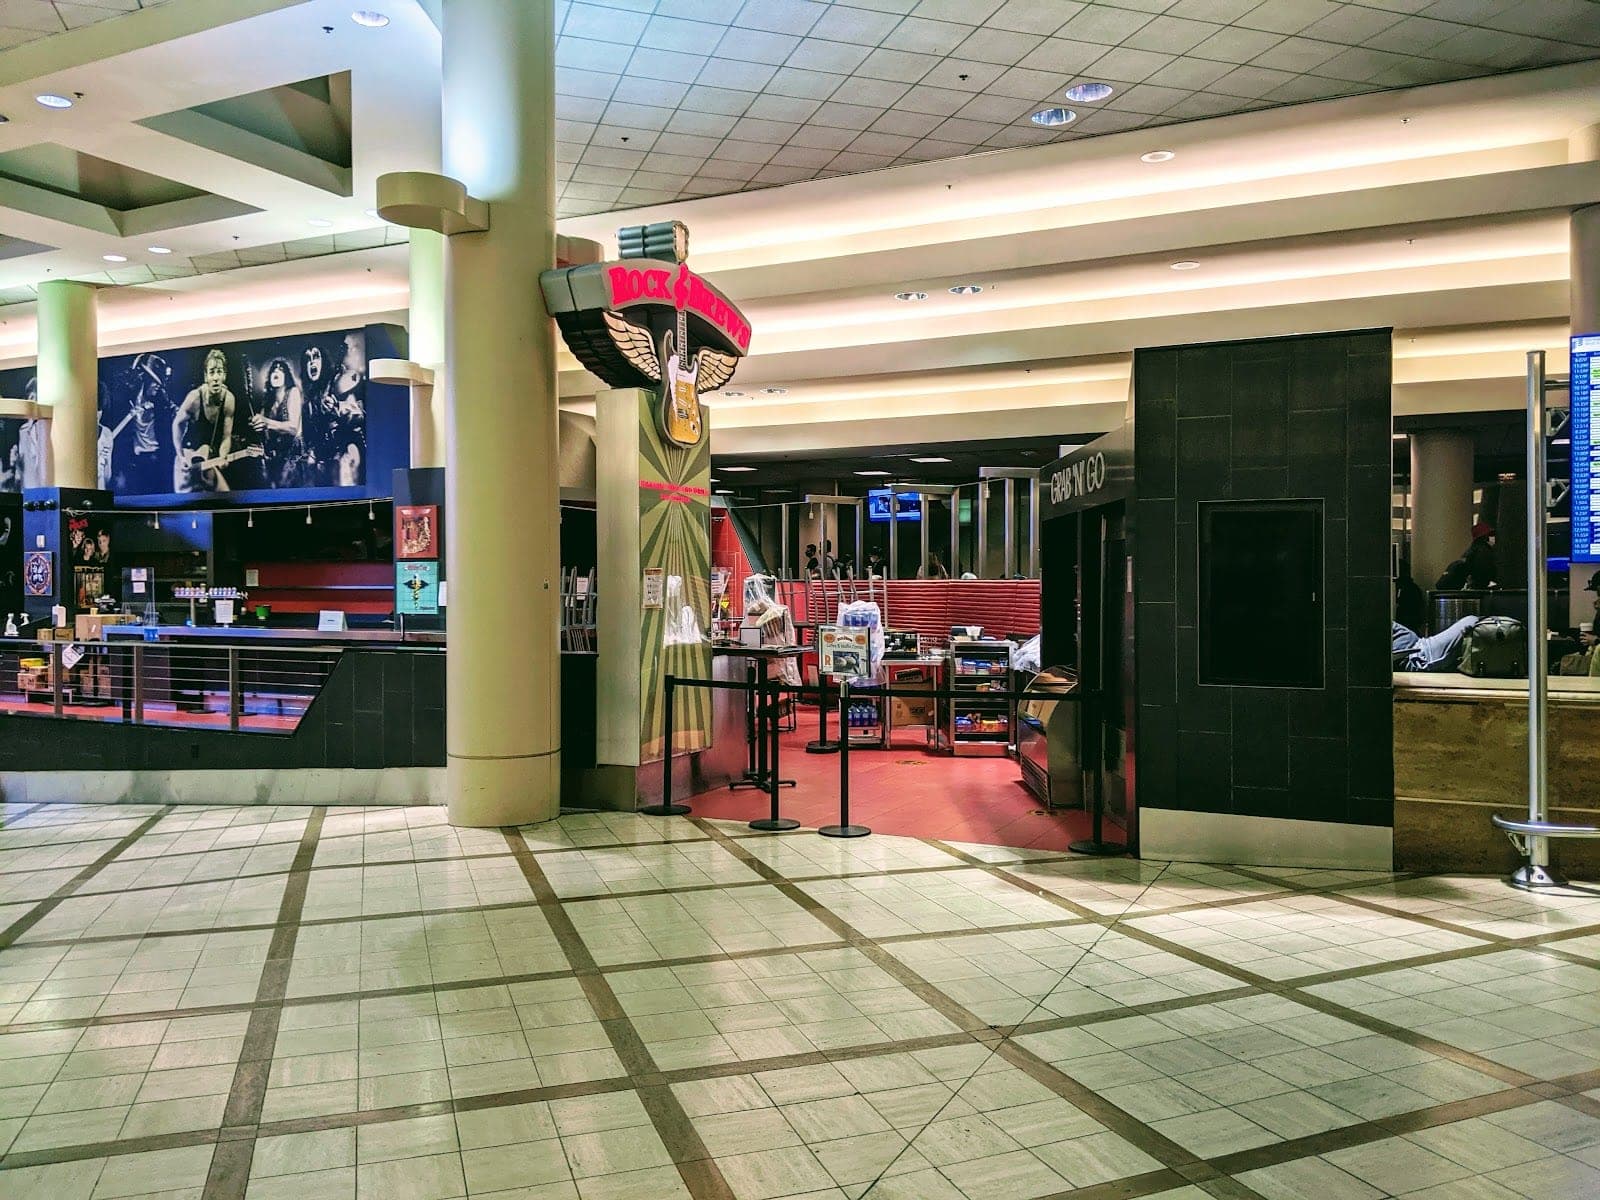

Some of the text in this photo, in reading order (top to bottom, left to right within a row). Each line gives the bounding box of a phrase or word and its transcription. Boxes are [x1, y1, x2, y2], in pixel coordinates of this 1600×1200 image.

[608, 266, 673, 305] ROCK
[1050, 467, 1072, 505] GRAB
[1086, 451, 1106, 493] GO
